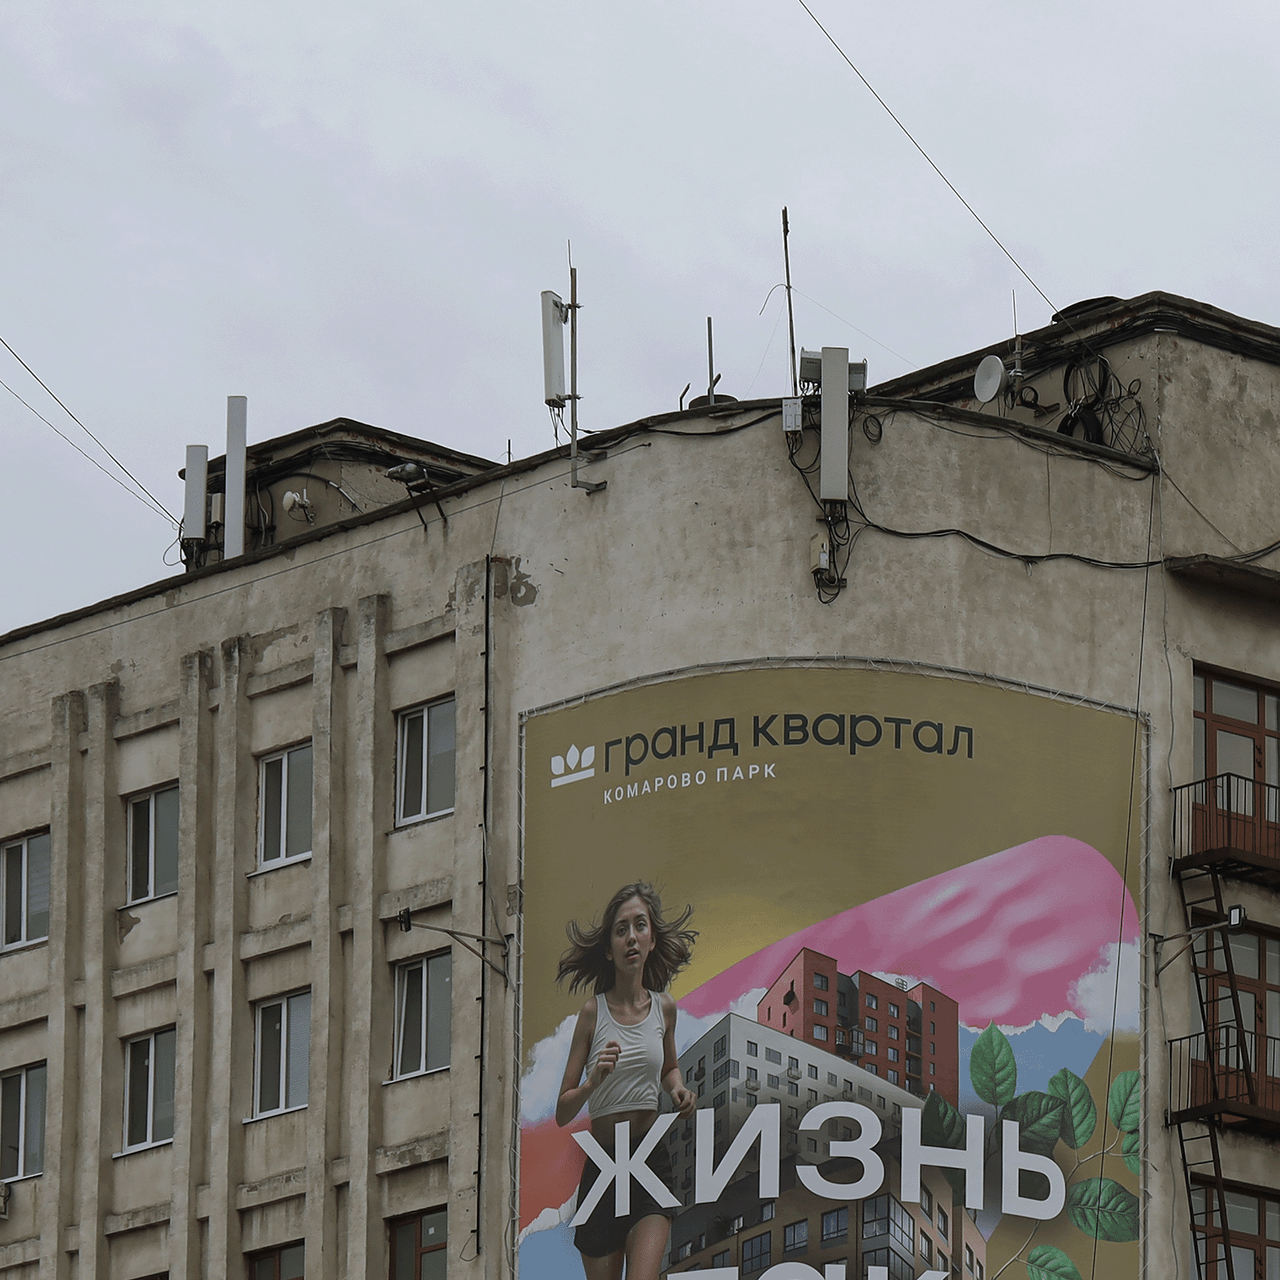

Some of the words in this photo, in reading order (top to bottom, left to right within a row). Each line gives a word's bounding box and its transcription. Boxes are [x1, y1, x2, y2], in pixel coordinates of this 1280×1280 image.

[605, 717, 739, 777] гранд
[752, 712, 974, 760] квартал
[603, 770, 707, 805] КОМАРОВО
[716, 763, 776, 783] ПАРК
[568, 1101, 1067, 1229] жизнь
